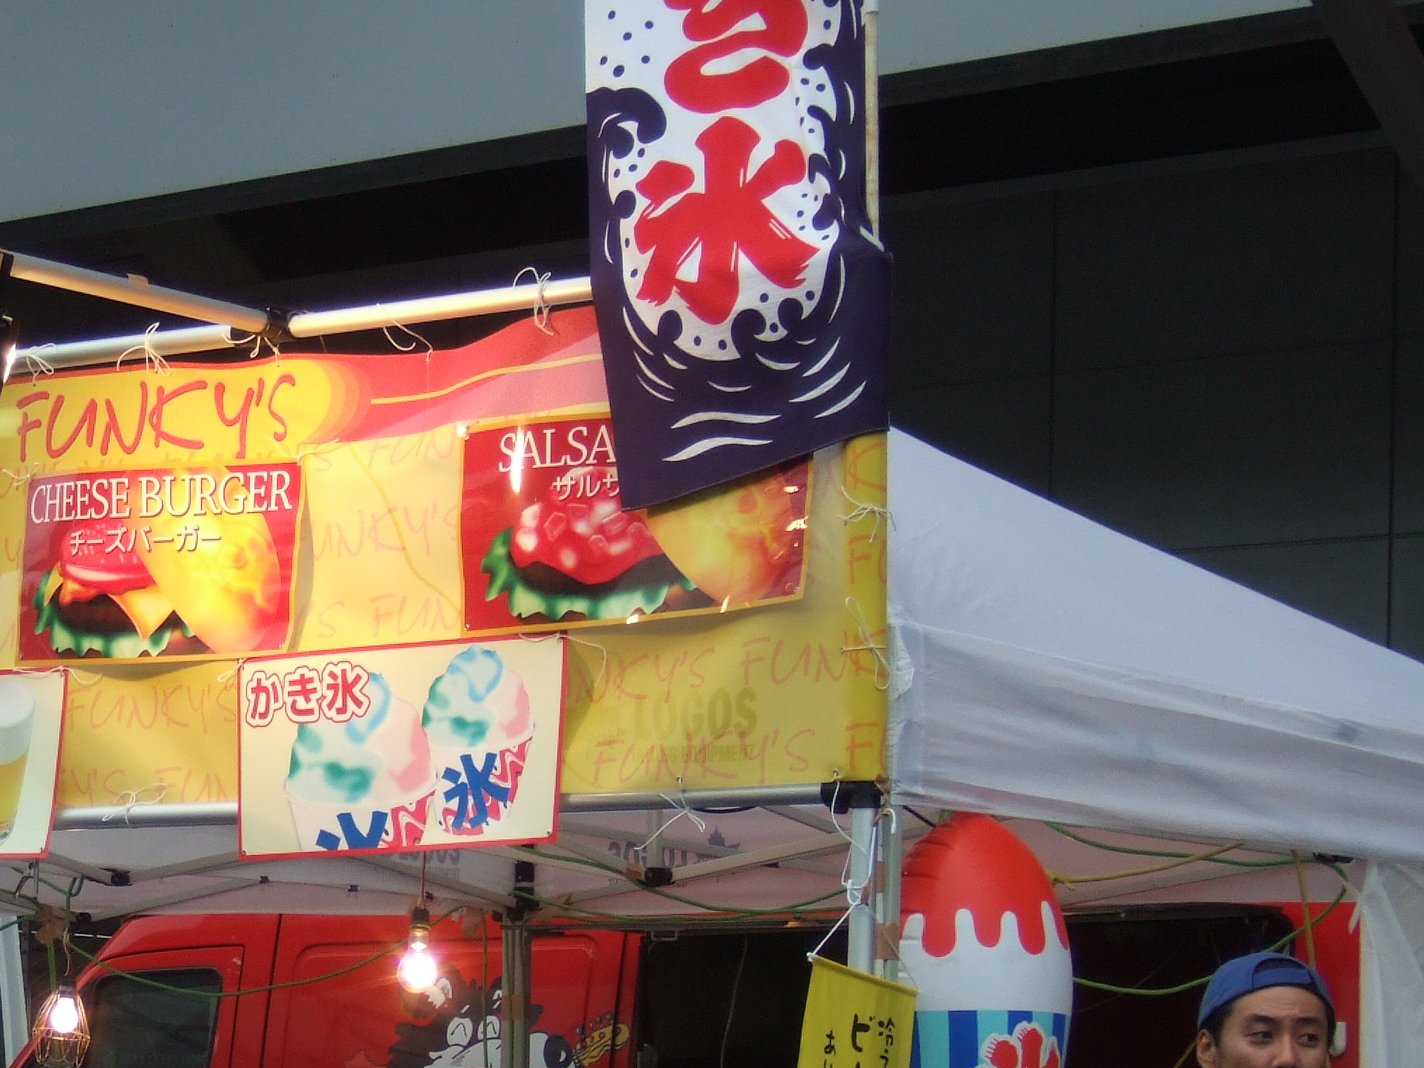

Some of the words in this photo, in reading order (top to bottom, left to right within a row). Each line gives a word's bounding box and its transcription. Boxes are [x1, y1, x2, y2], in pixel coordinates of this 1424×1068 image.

[15, 374, 296, 463] FUNKY'S
[498, 425, 616, 473] SALSA
[30, 477, 131, 523] CHEESE
[138, 471, 292, 518] BURGER
[70, 525, 221, 555] チーズバーガー
[248, 664, 366, 723] かき氷
[442, 753, 510, 828] 氷
